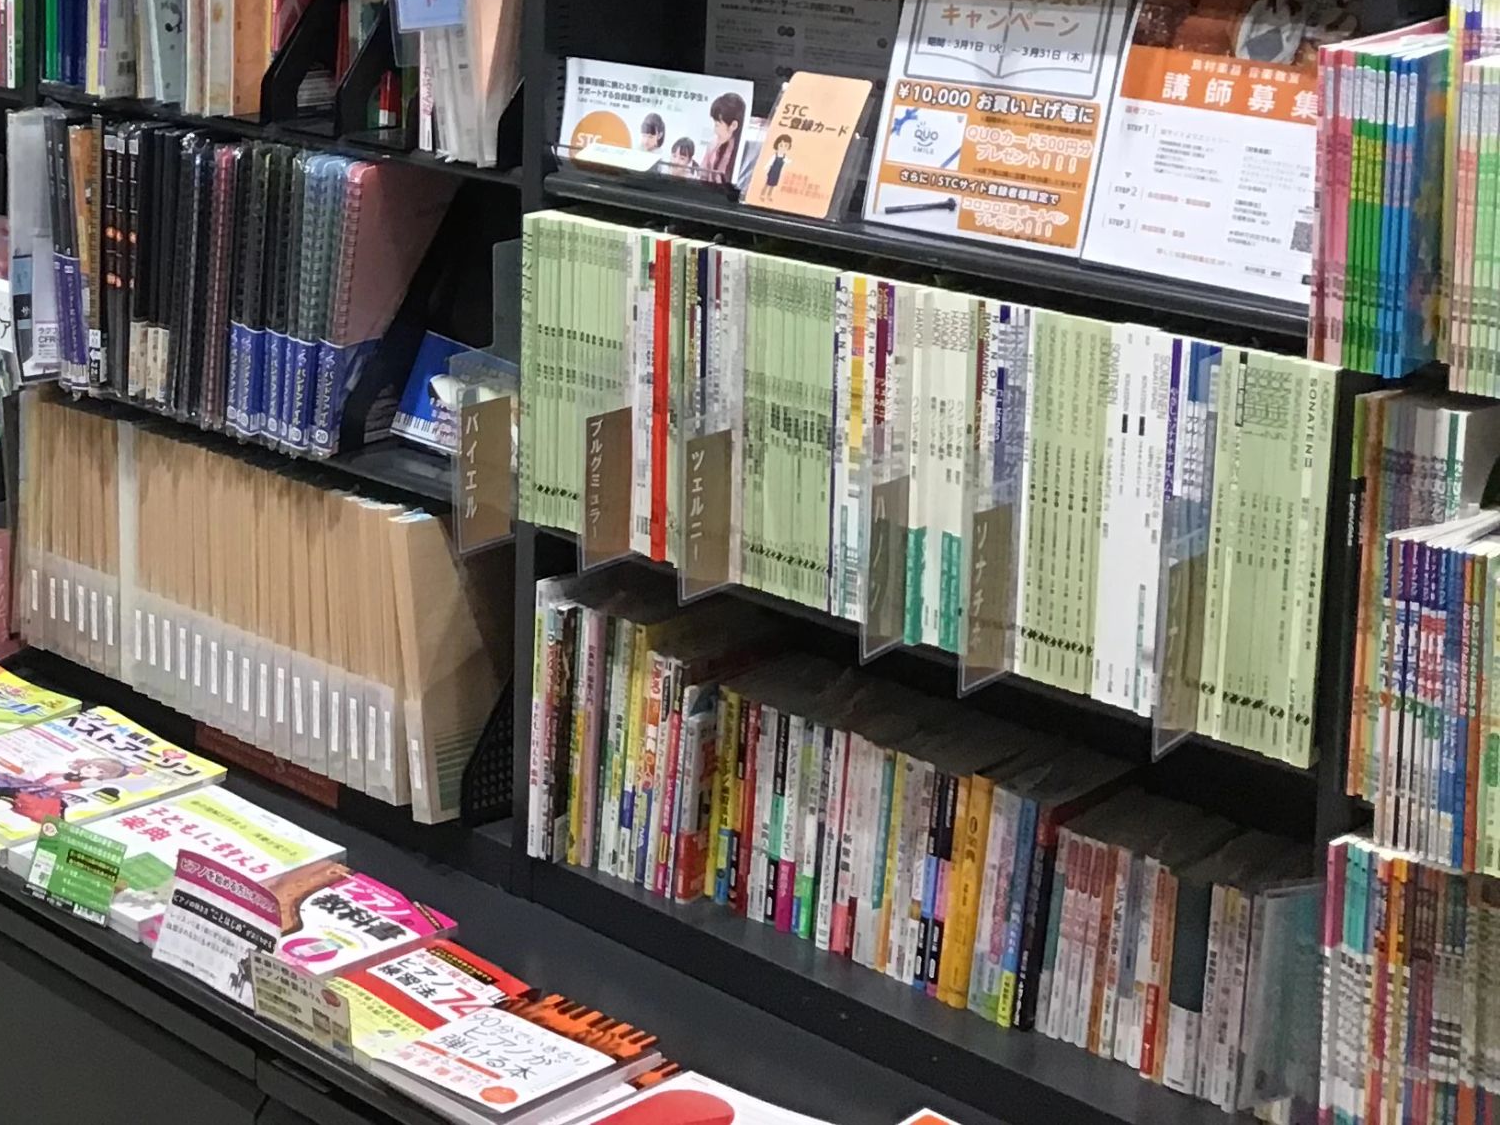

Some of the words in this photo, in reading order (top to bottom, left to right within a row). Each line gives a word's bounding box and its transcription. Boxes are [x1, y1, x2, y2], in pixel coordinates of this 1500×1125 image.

[940, 3, 1080, 37] キャンペーン
[782, 103, 810, 118] STC
[898, 82, 971, 107] ¥10,000
[976, 92, 1096, 125] お買い上げ毎に
[1161, 70, 1319, 121] 講師募集
[778, 116, 850, 139] ご登録カード
[914, 128, 939, 142] QUO
[965, 125, 1094, 158] QUOカード500円分
[722, 260, 730, 336] CZERNY
[838, 286, 849, 362] CZERNY
[867, 289, 877, 369] CZERNY
[914, 307, 924, 348] HANON
[932, 309, 942, 346] HANON
[940, 312, 950, 350] HANON
[949, 310, 959, 351] HANON
[959, 312, 969, 353] HANON
[990, 315, 999, 398] HANON
[1157, 355, 1170, 420] SONATINEN
[1305, 378, 1318, 455] SONATEN
[464, 412, 479, 520] バイエル
[588, 418, 604, 540] ブルグミュラー
[689, 448, 706, 563] ツェルニー
[62, 715, 201, 776] ベストアニソン
[116, 814, 173, 843] 楽典
[147, 806, 271, 874] 子どもに教える
[310, 892, 407, 942] 教科書
[377, 963, 438, 999] 練習法
[397, 957, 454, 986] ピアノ
[433, 1033, 538, 1081] 弾ける本
[462, 1026, 562, 1067] ピアノが
[467, 1012, 591, 1067] 90分でいきなり
